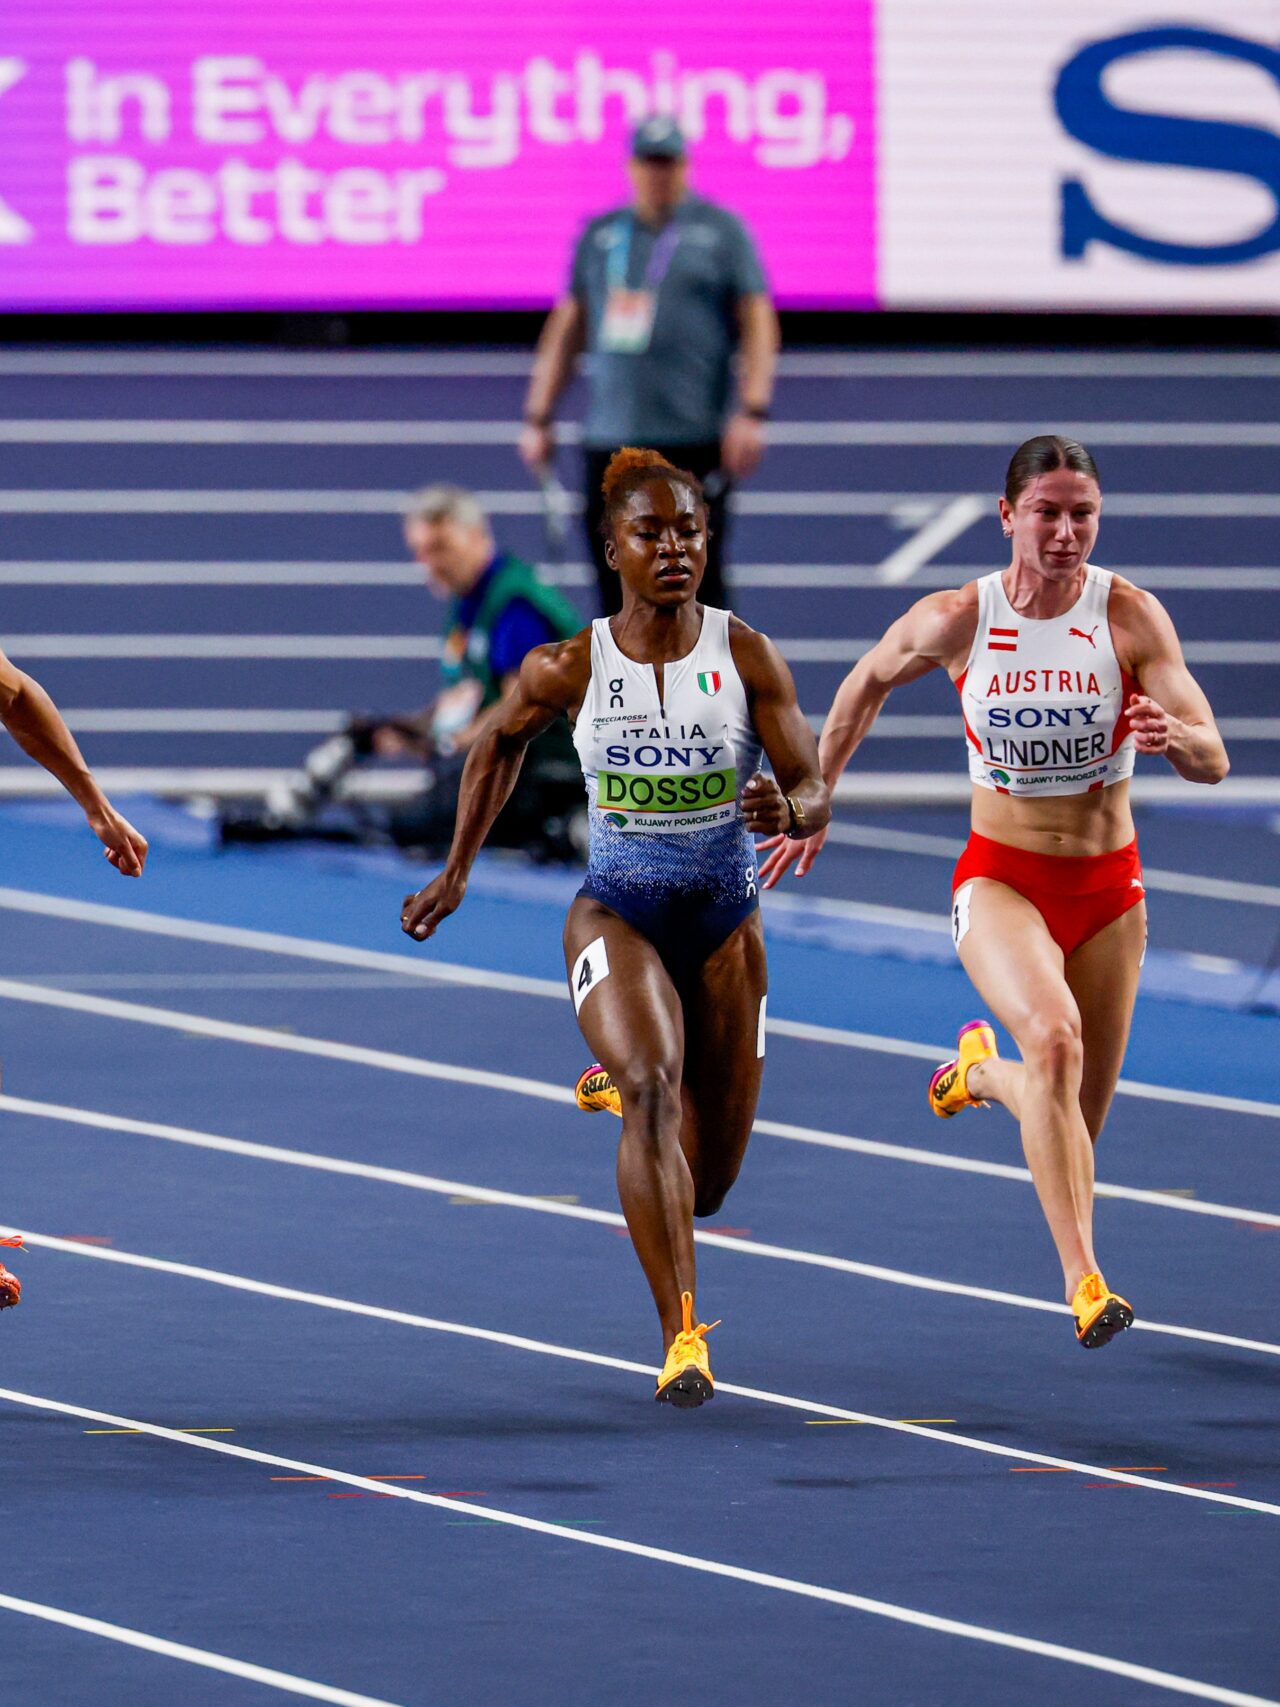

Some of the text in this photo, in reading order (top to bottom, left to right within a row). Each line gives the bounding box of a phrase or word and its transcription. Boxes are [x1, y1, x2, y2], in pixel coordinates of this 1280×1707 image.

[64, 52, 854, 168] In Everything,
[65, 154, 446, 245] Better
[986, 670, 1101, 698] AUSTRIA
[592, 714, 648, 724] FRECCIAROSSA
[988, 704, 1101, 728] SONY
[606, 745, 723, 767] SONY
[986, 732, 1106, 767] LINDNER
[606, 772, 726, 806] DOSSO
[1016, 776, 1054, 785] KUJAWY
[1055, 769, 1097, 783] POMORZE
[634, 809, 731, 827] KUJAWY POMORZE 26
[578, 956, 594, 992] 4
